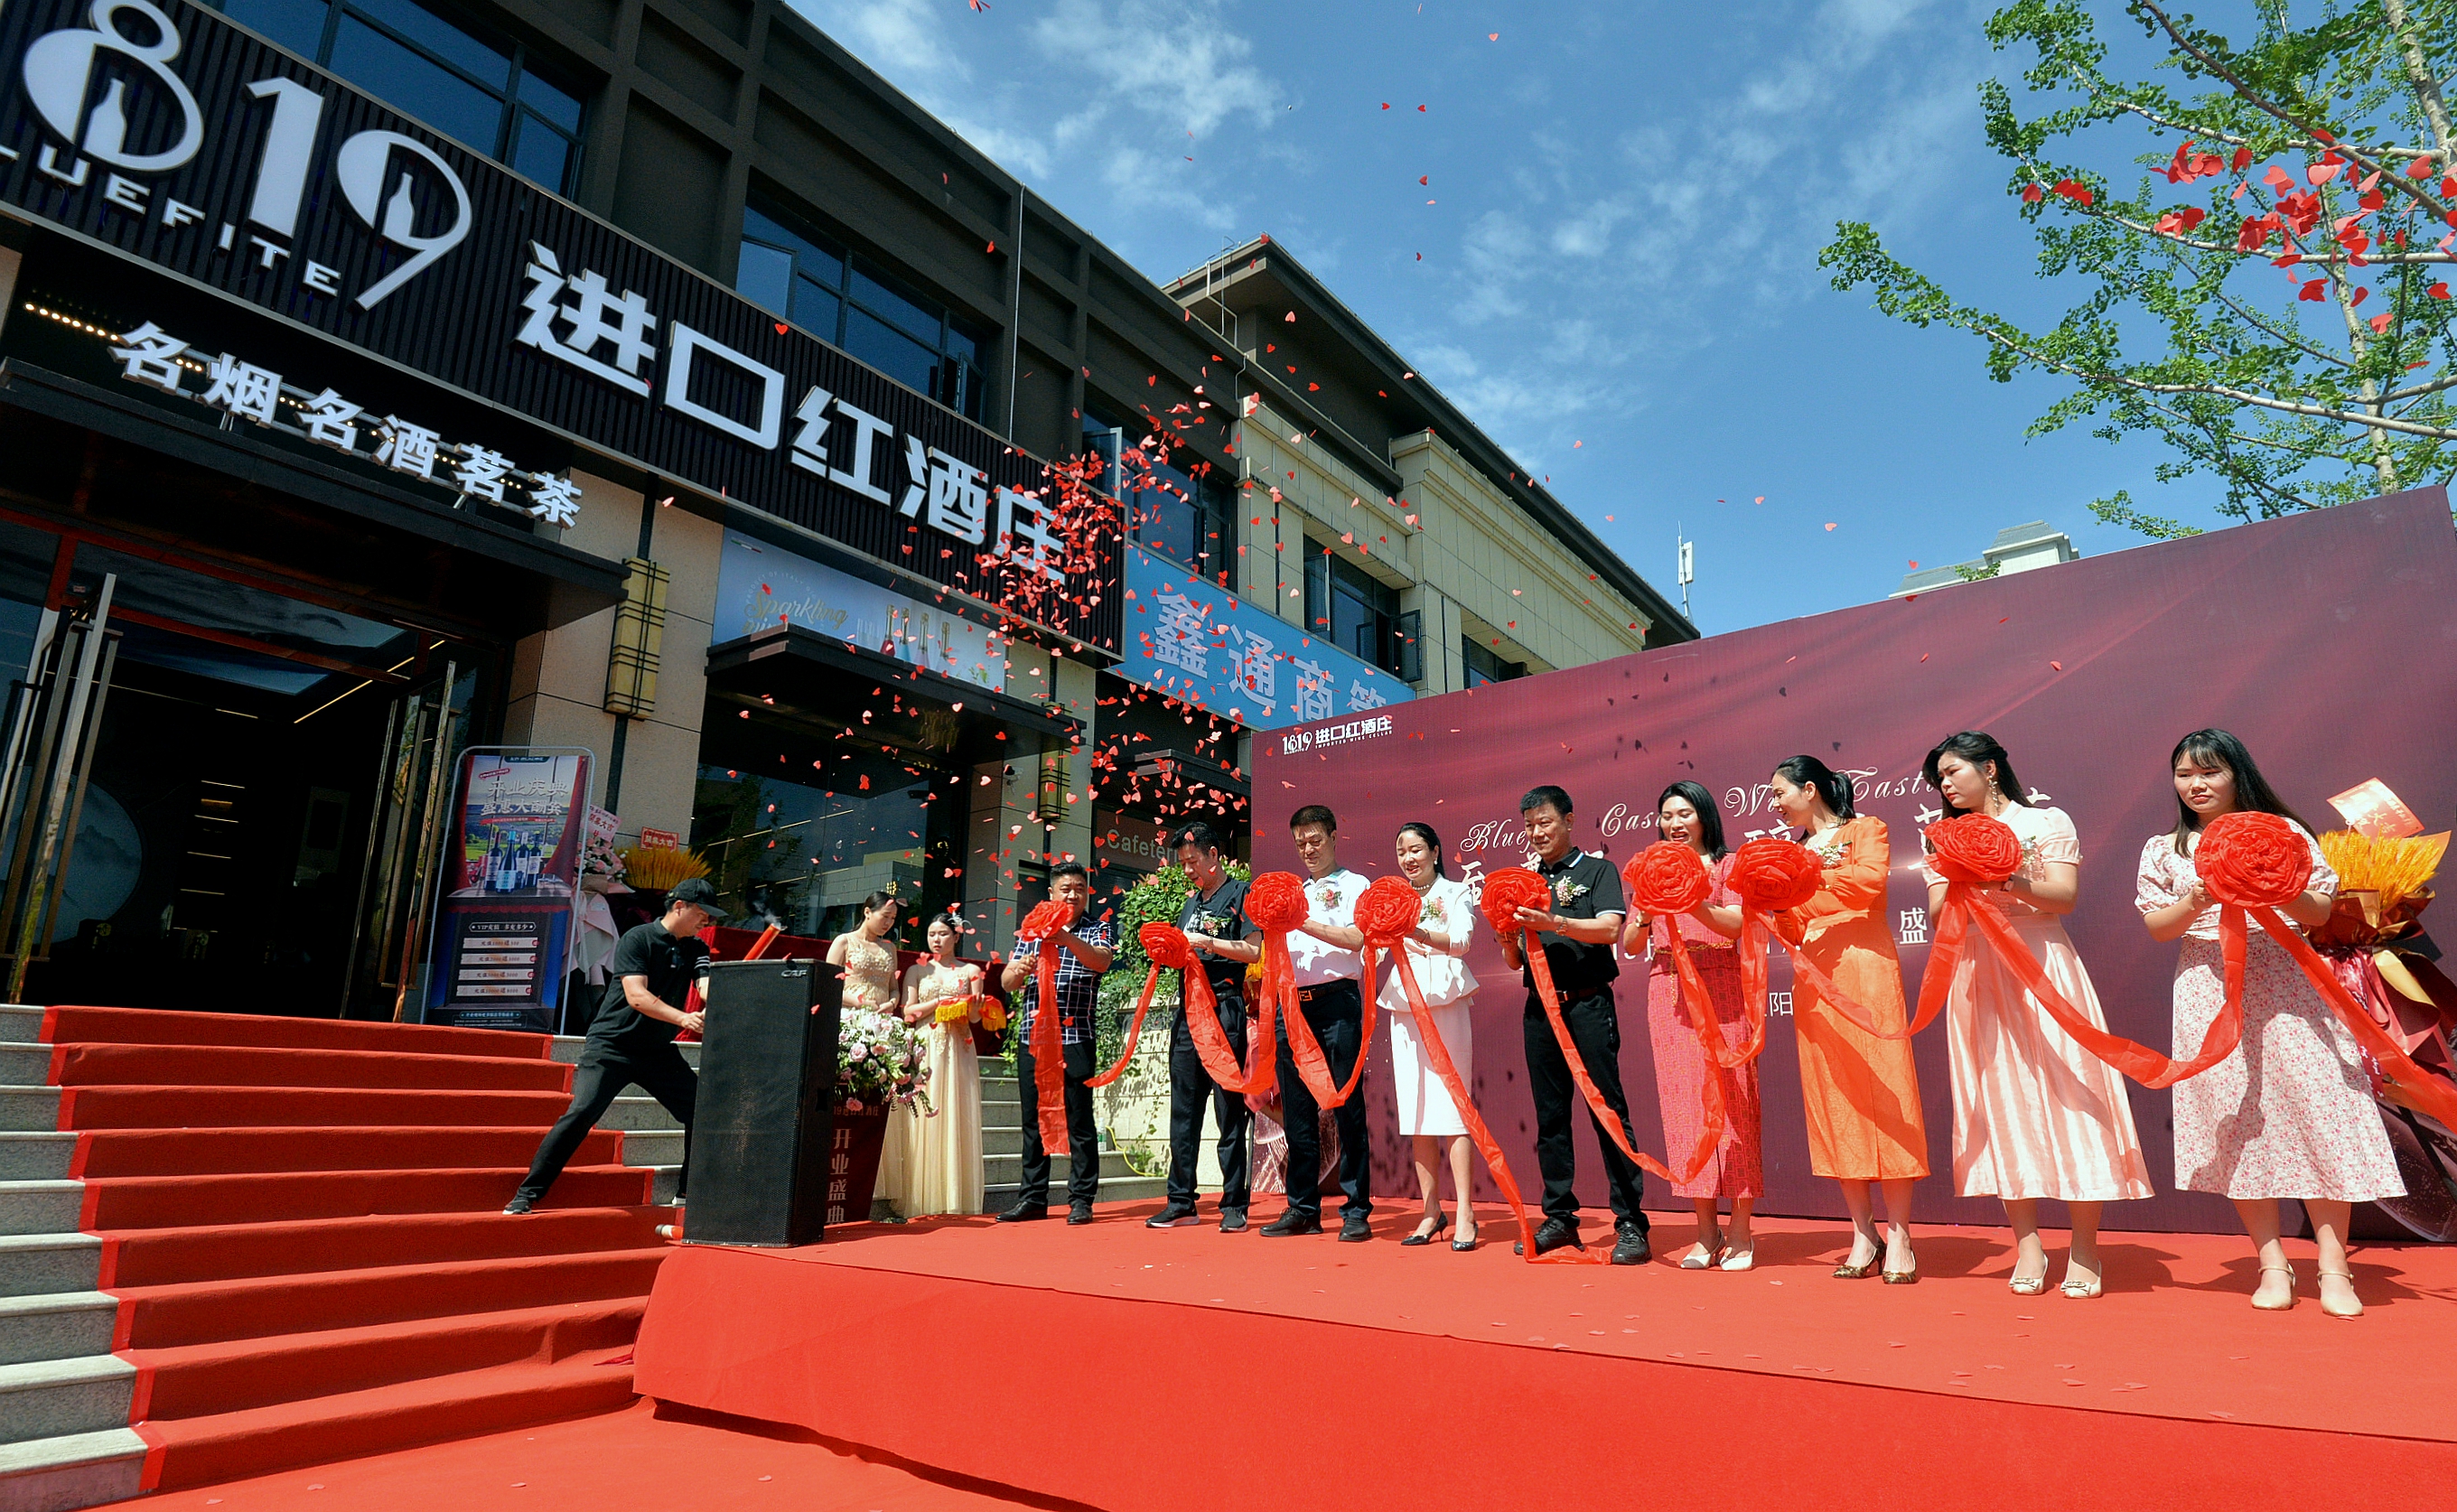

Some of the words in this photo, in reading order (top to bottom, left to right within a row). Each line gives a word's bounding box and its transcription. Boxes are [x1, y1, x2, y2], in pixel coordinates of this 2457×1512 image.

[107, 320, 583, 530] 名烟名酒茗茶
[511, 238, 1067, 585] 进口红酒庄
[744, 592, 847, 630] Sparkling
[1283, 731, 1313, 751] 1819
[1315, 716, 1393, 744] 进口红酒庄
[1369, 730, 1393, 739] CELLAR
[1899, 907, 1928, 945] 盛
[1769, 992, 1794, 1017] 阳
[826, 1128, 852, 1225] 开业盛典
